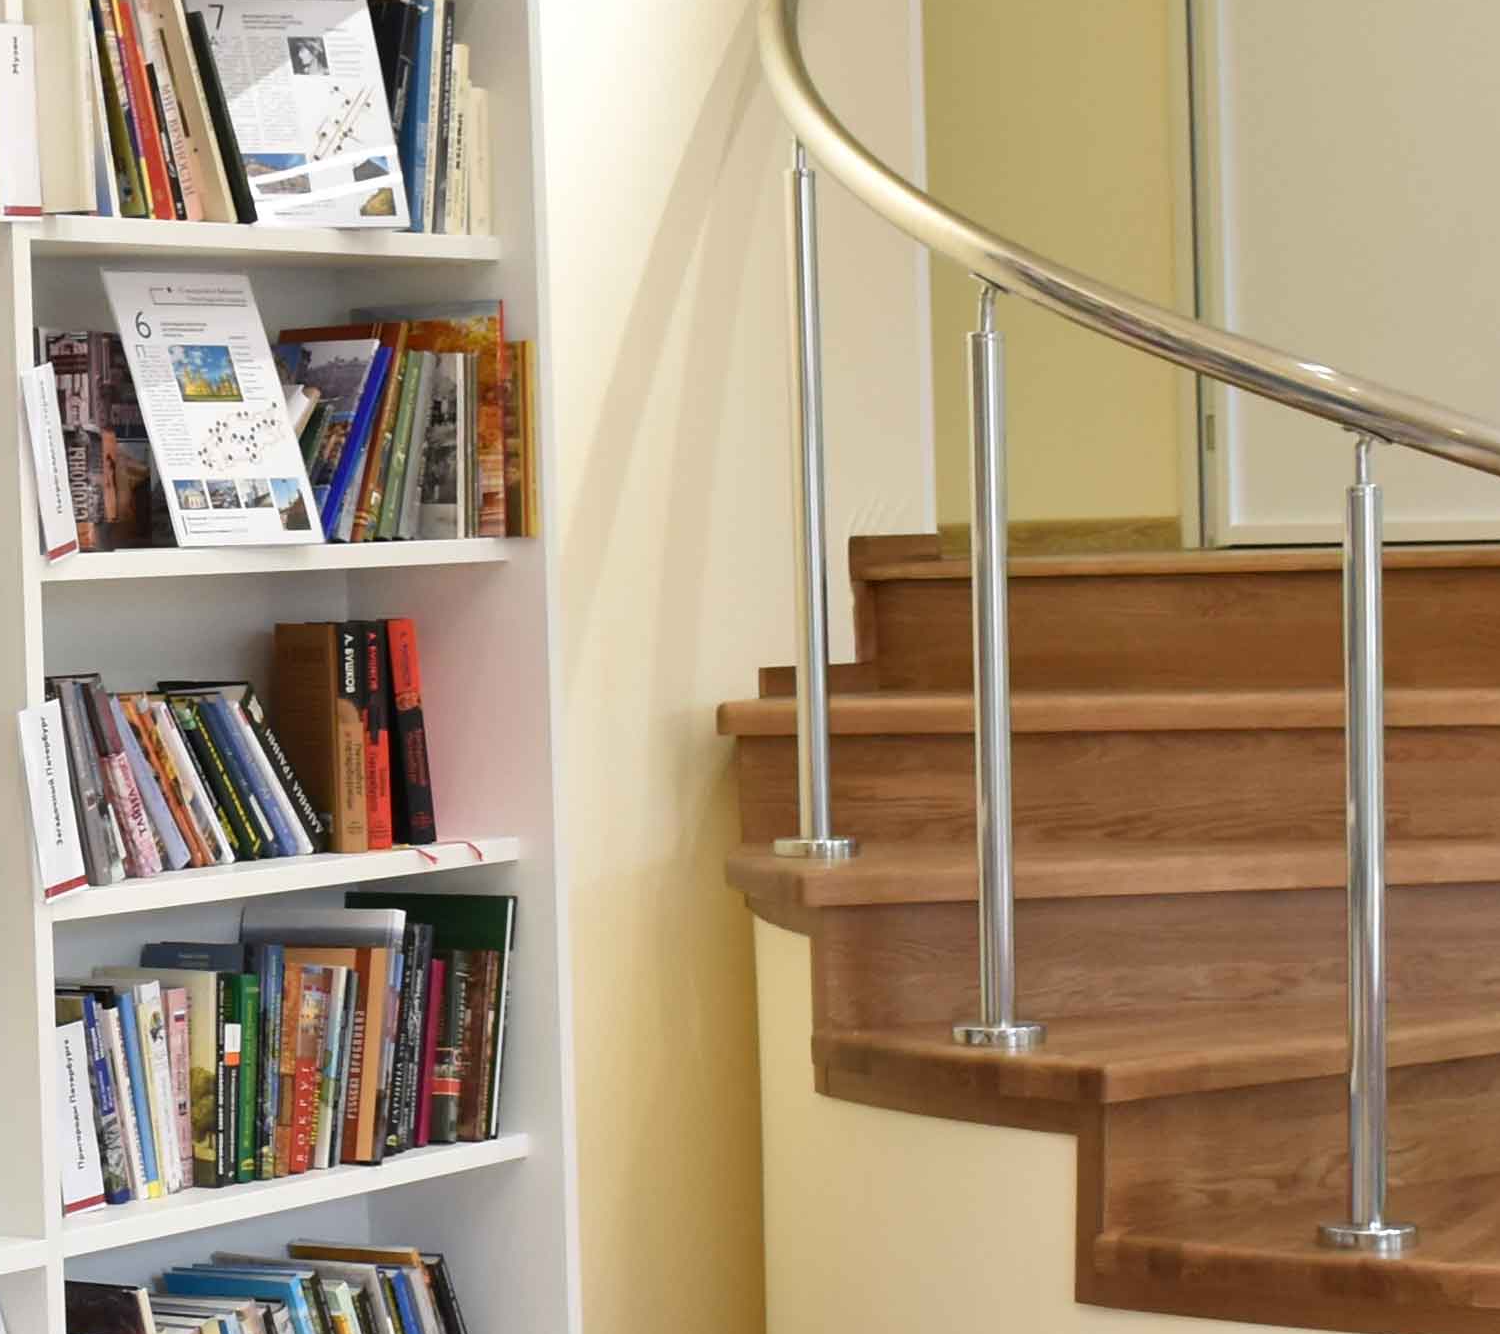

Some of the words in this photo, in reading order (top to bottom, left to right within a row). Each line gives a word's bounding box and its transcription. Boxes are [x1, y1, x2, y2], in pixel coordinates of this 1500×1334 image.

[207, 3, 225, 29] 7
[134, 311, 152, 340] 6
[342, 646, 356, 694] БУШКОВ
[64, 1037, 80, 1105] Петербурга
[75, 1104, 88, 1173] Пригороды
